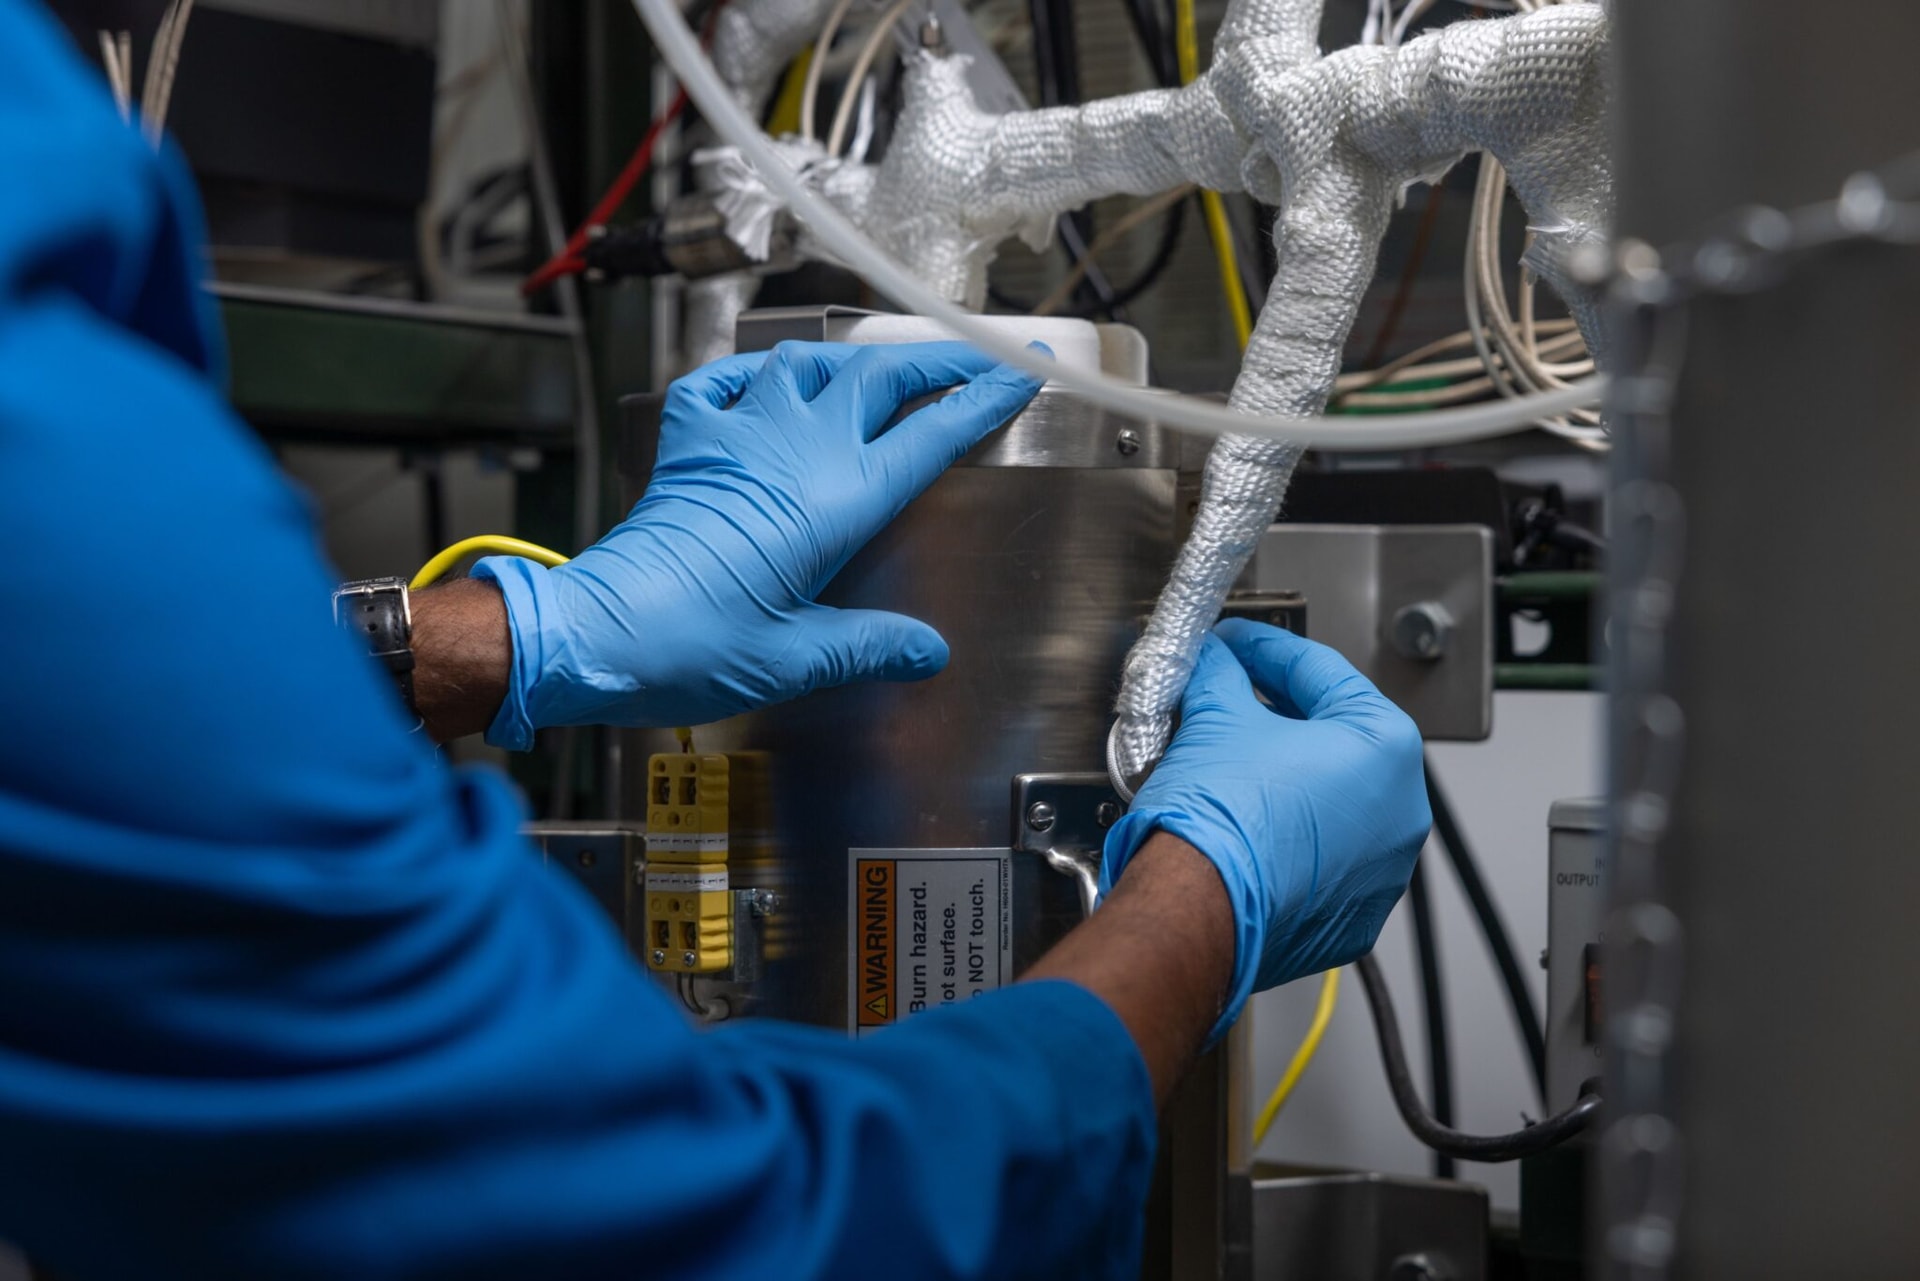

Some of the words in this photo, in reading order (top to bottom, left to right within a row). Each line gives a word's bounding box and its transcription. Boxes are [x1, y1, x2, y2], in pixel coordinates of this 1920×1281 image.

[968, 878, 984, 937] touch.
[1556, 872, 1600, 887] OUTPUT
[866, 867, 888, 994] WARNING
[909, 881, 927, 958] hazard.
[940, 902, 956, 977] surface.
[909, 964, 927, 1014] Burn
[968, 942, 984, 983] NOT
